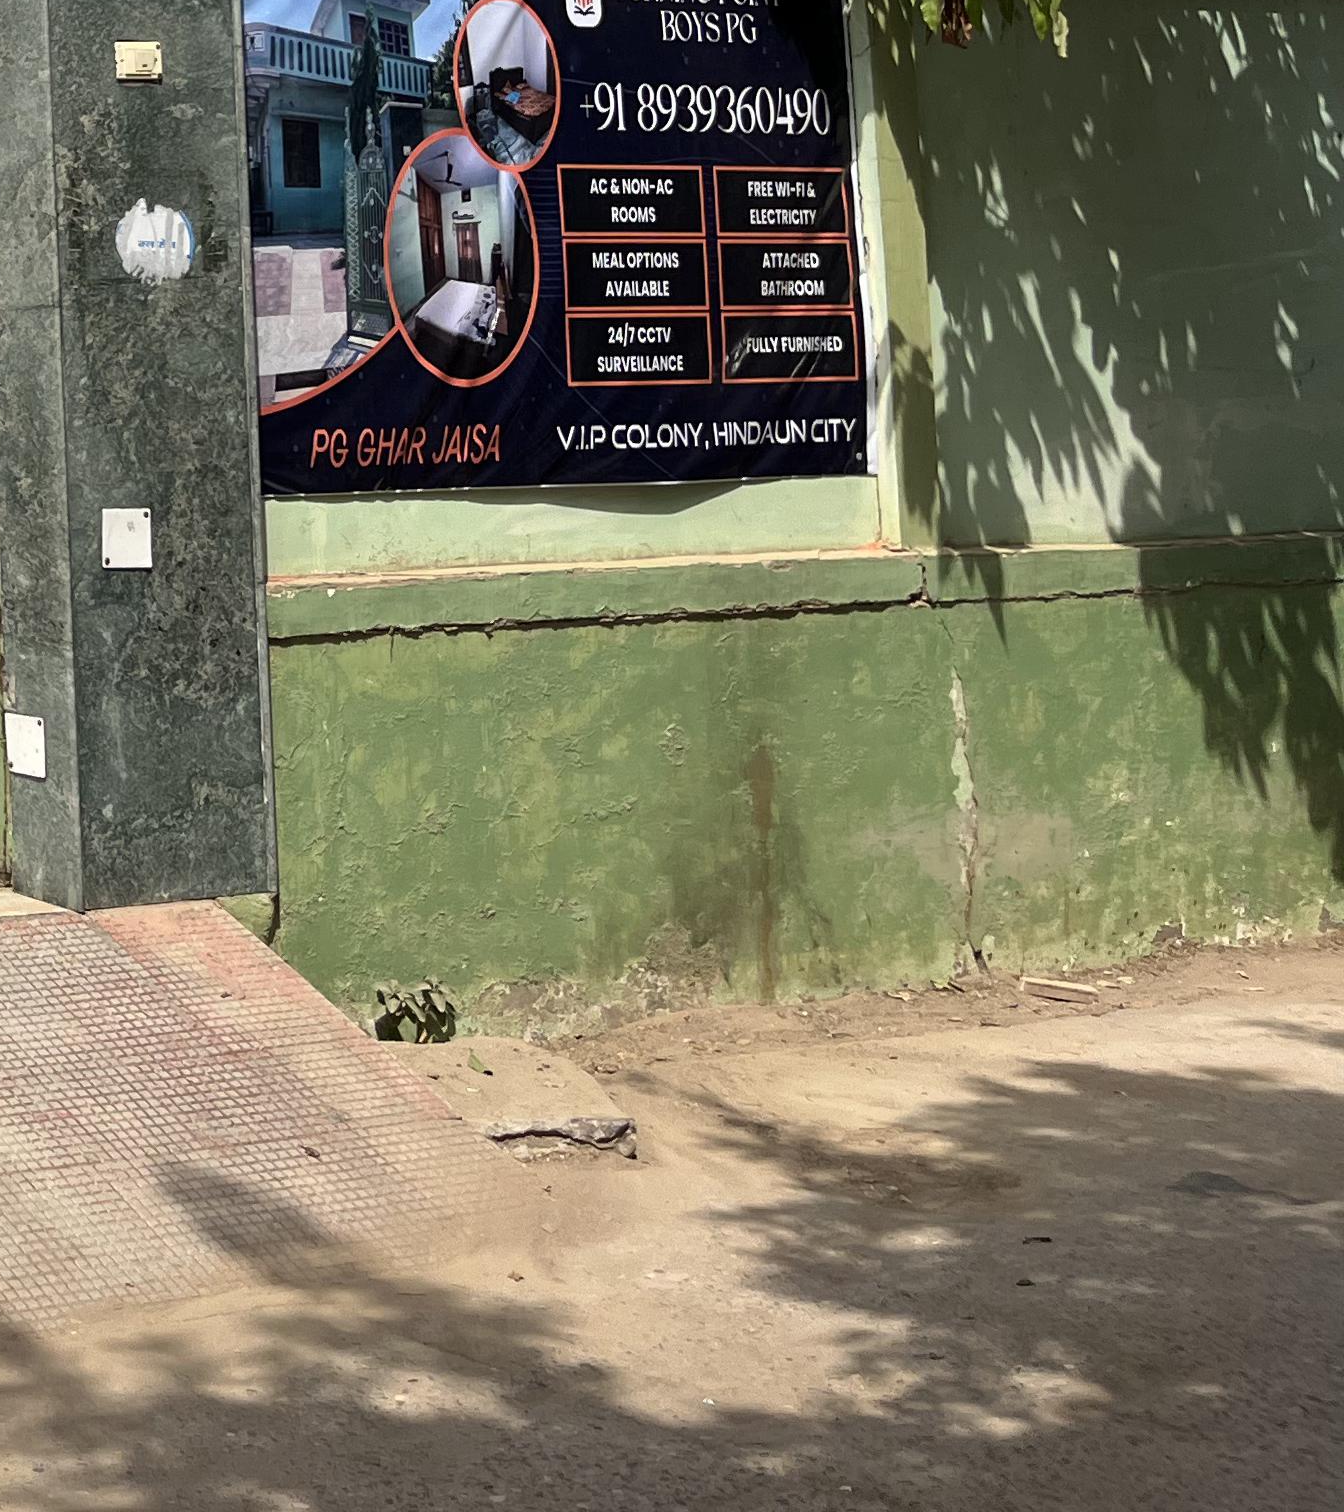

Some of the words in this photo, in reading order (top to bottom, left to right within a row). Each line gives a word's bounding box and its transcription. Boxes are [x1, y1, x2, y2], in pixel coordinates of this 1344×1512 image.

[660, 9, 721, 43] BOYS
[726, 12, 758, 44] PG
[579, 81, 627, 132] +91
[636, 82, 831, 136] 8939360490
[589, 178, 608, 195] AC
[610, 178, 621, 195] &
[622, 178, 674, 195] NON-AC
[747, 180, 774, 197] FREE
[775, 181, 805, 198] WI-FI
[806, 182, 816, 198] &
[611, 206, 656, 223] ROOMS
[749, 208, 816, 225] ELECTRICITY
[592, 252, 625, 268] MEAL
[626, 252, 679, 269] OPTIONS
[762, 252, 820, 269] ATTACHED
[605, 280, 670, 297] AVAILABLE
[760, 280, 825, 296] BATHROOM
[607, 322, 635, 347] 24/7
[637, 326, 671, 343] CCTV
[746, 336, 779, 353] FULLY
[780, 336, 843, 352] FURNISHED
[597, 355, 684, 372] SURVEILLANCE
[556, 424, 606, 451] V.I.P
[611, 422, 710, 451] COLONY,
[713, 419, 807, 447] HINDAUN
[811, 418, 857, 443] CITY
[310, 427, 349, 469] PG
[357, 426, 427, 467] GHAR
[432, 423, 501, 464] JAISA
